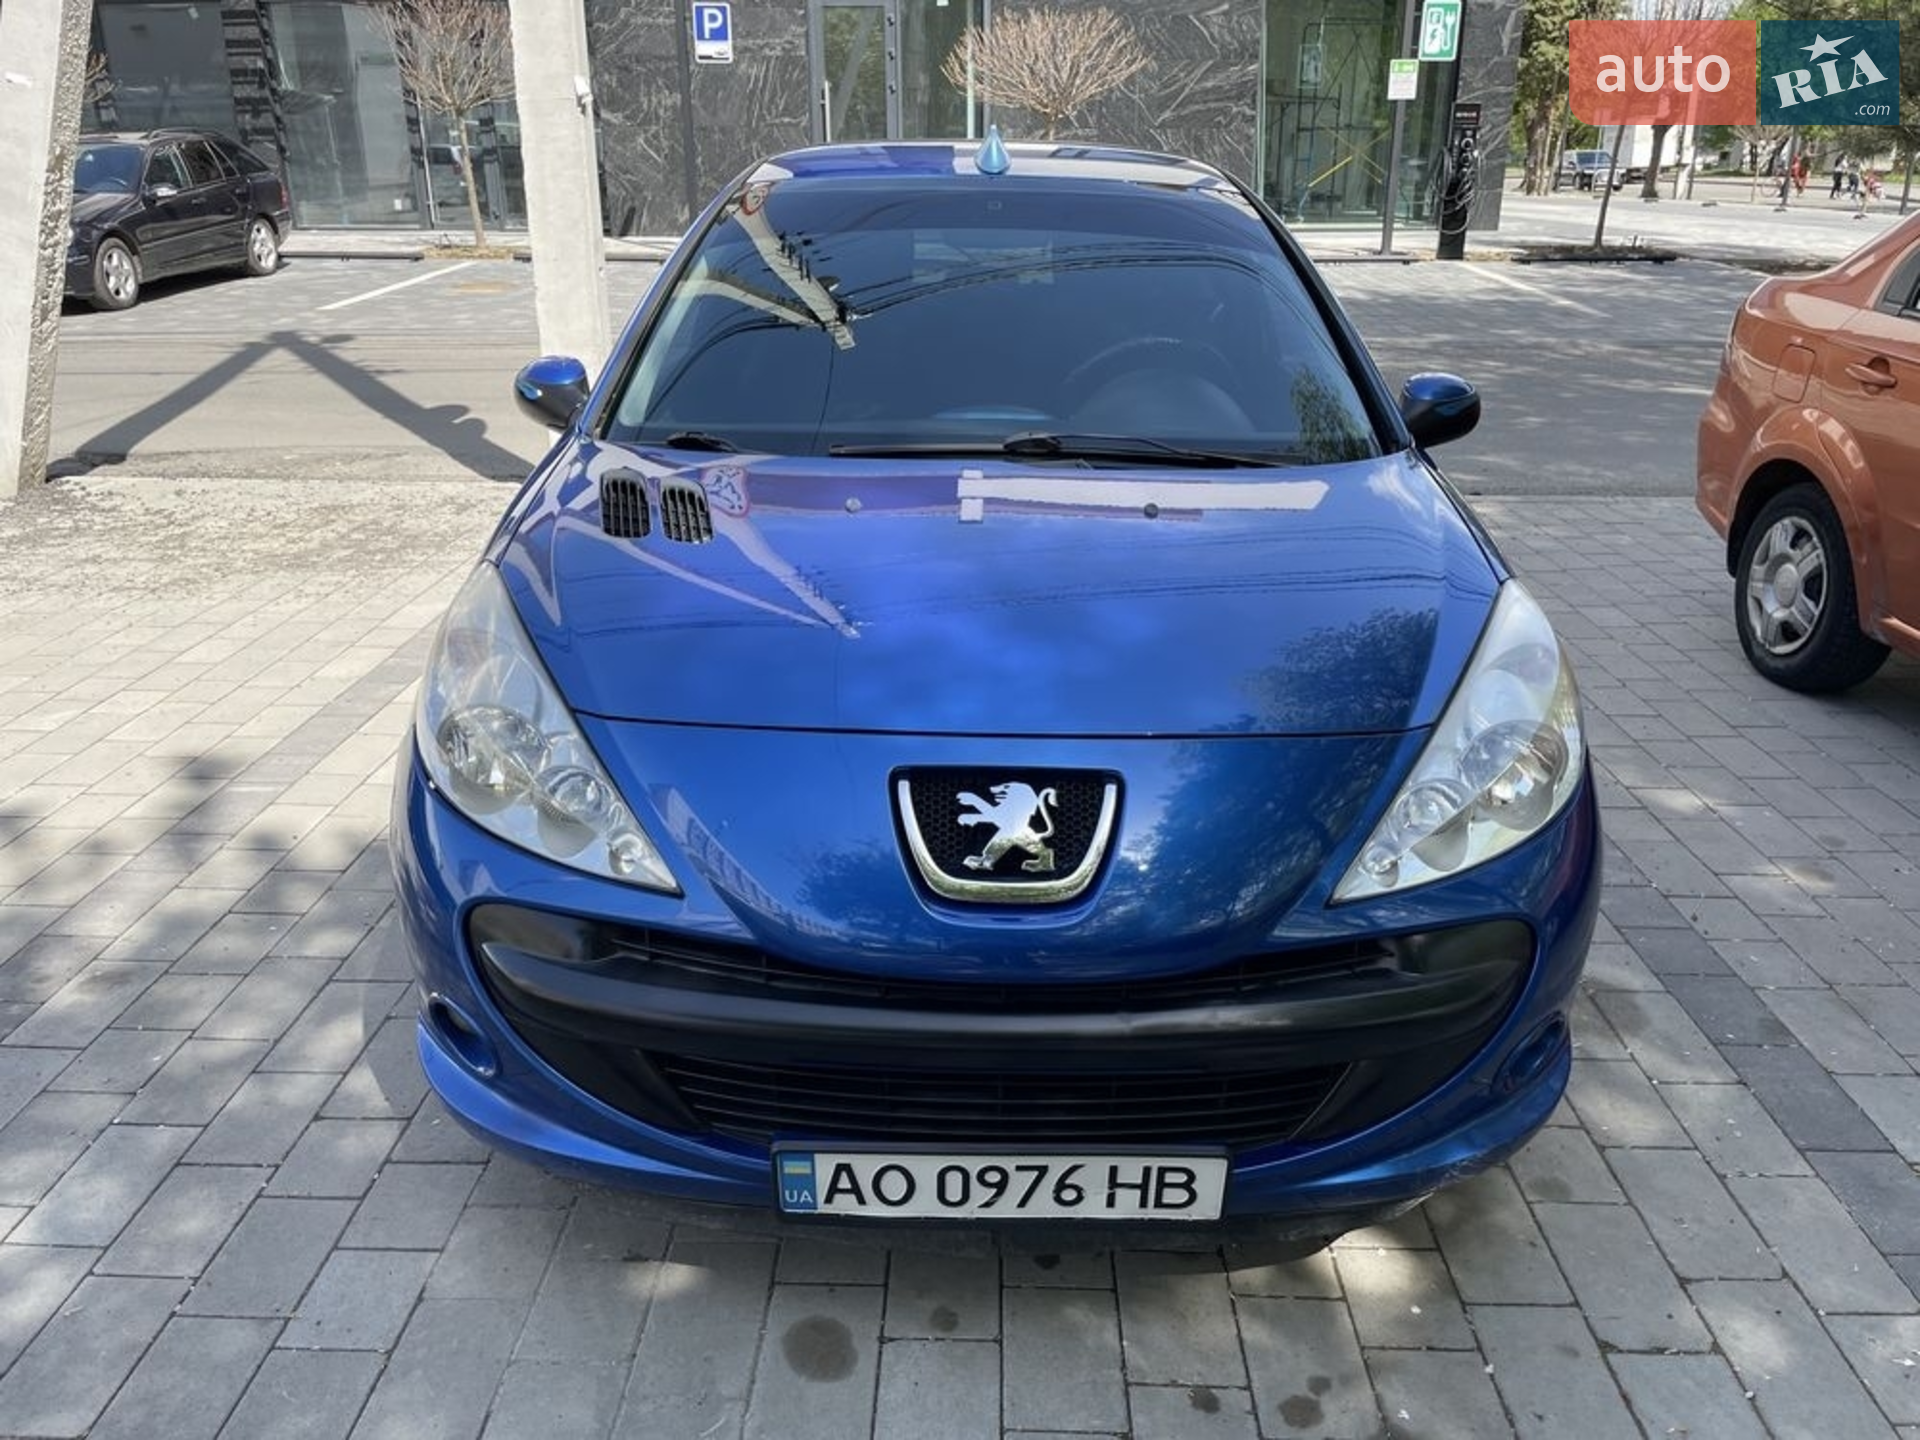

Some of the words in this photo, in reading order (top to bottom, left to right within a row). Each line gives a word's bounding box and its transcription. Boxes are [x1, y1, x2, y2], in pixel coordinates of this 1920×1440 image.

[703, 8, 723, 39] P
[784, 1190, 813, 1204] UA
[823, 1162, 916, 1207] AO
[936, 1164, 1085, 1209] 0976
[1105, 1164, 1198, 1209] HB
